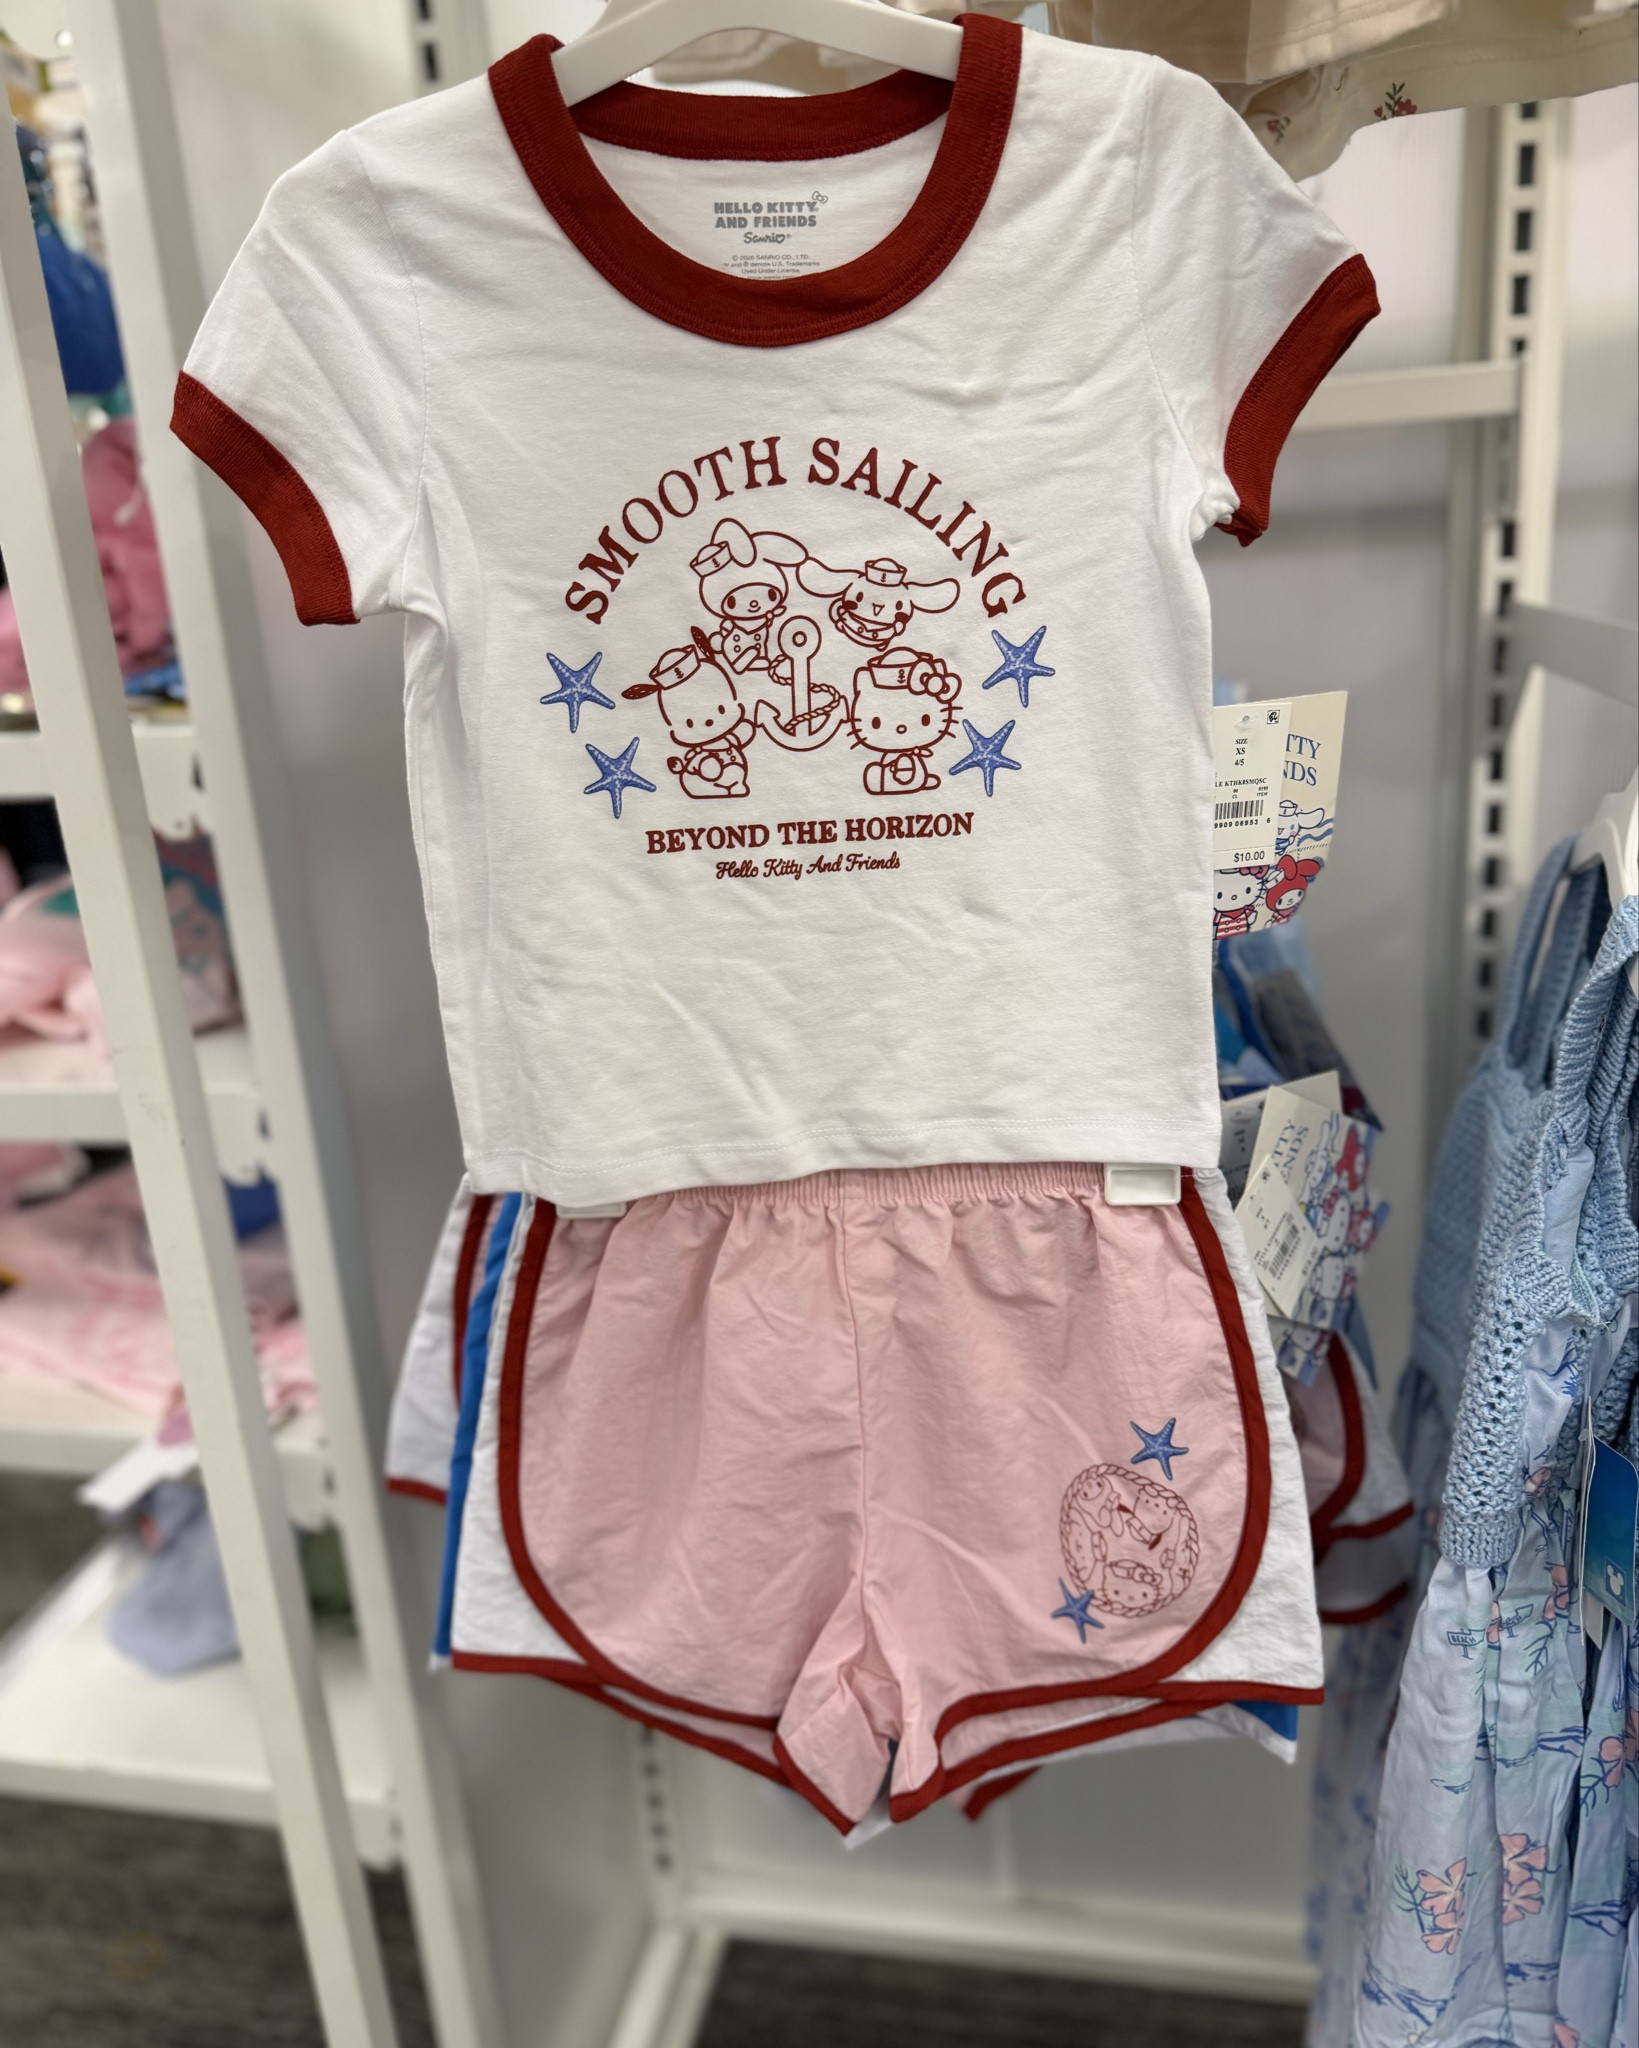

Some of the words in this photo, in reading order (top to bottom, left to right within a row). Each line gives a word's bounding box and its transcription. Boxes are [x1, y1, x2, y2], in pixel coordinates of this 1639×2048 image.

[714, 202, 763, 214] HELLO
[767, 201, 818, 213] KITTY
[715, 216, 748, 229] AND
[754, 215, 817, 228] FRIENDS
[743, 231, 786, 244] Sanrio
[565, 436, 787, 624] SMOOTH
[808, 437, 1026, 617] SAILING
[1235, 747, 1246, 756] XS
[1234, 758, 1245, 766] 4/5
[646, 823, 770, 854] BEYOND
[777, 820, 837, 846] THE
[845, 812, 974, 842] HORIZON
[1233, 850, 1266, 863] $10.00
[715, 860, 759, 880] Hello
[763, 858, 803, 881] Kitty
[806, 854, 842, 874] And
[846, 851, 900, 872] Friends
[1450, 1634, 1476, 1644] BEACH
